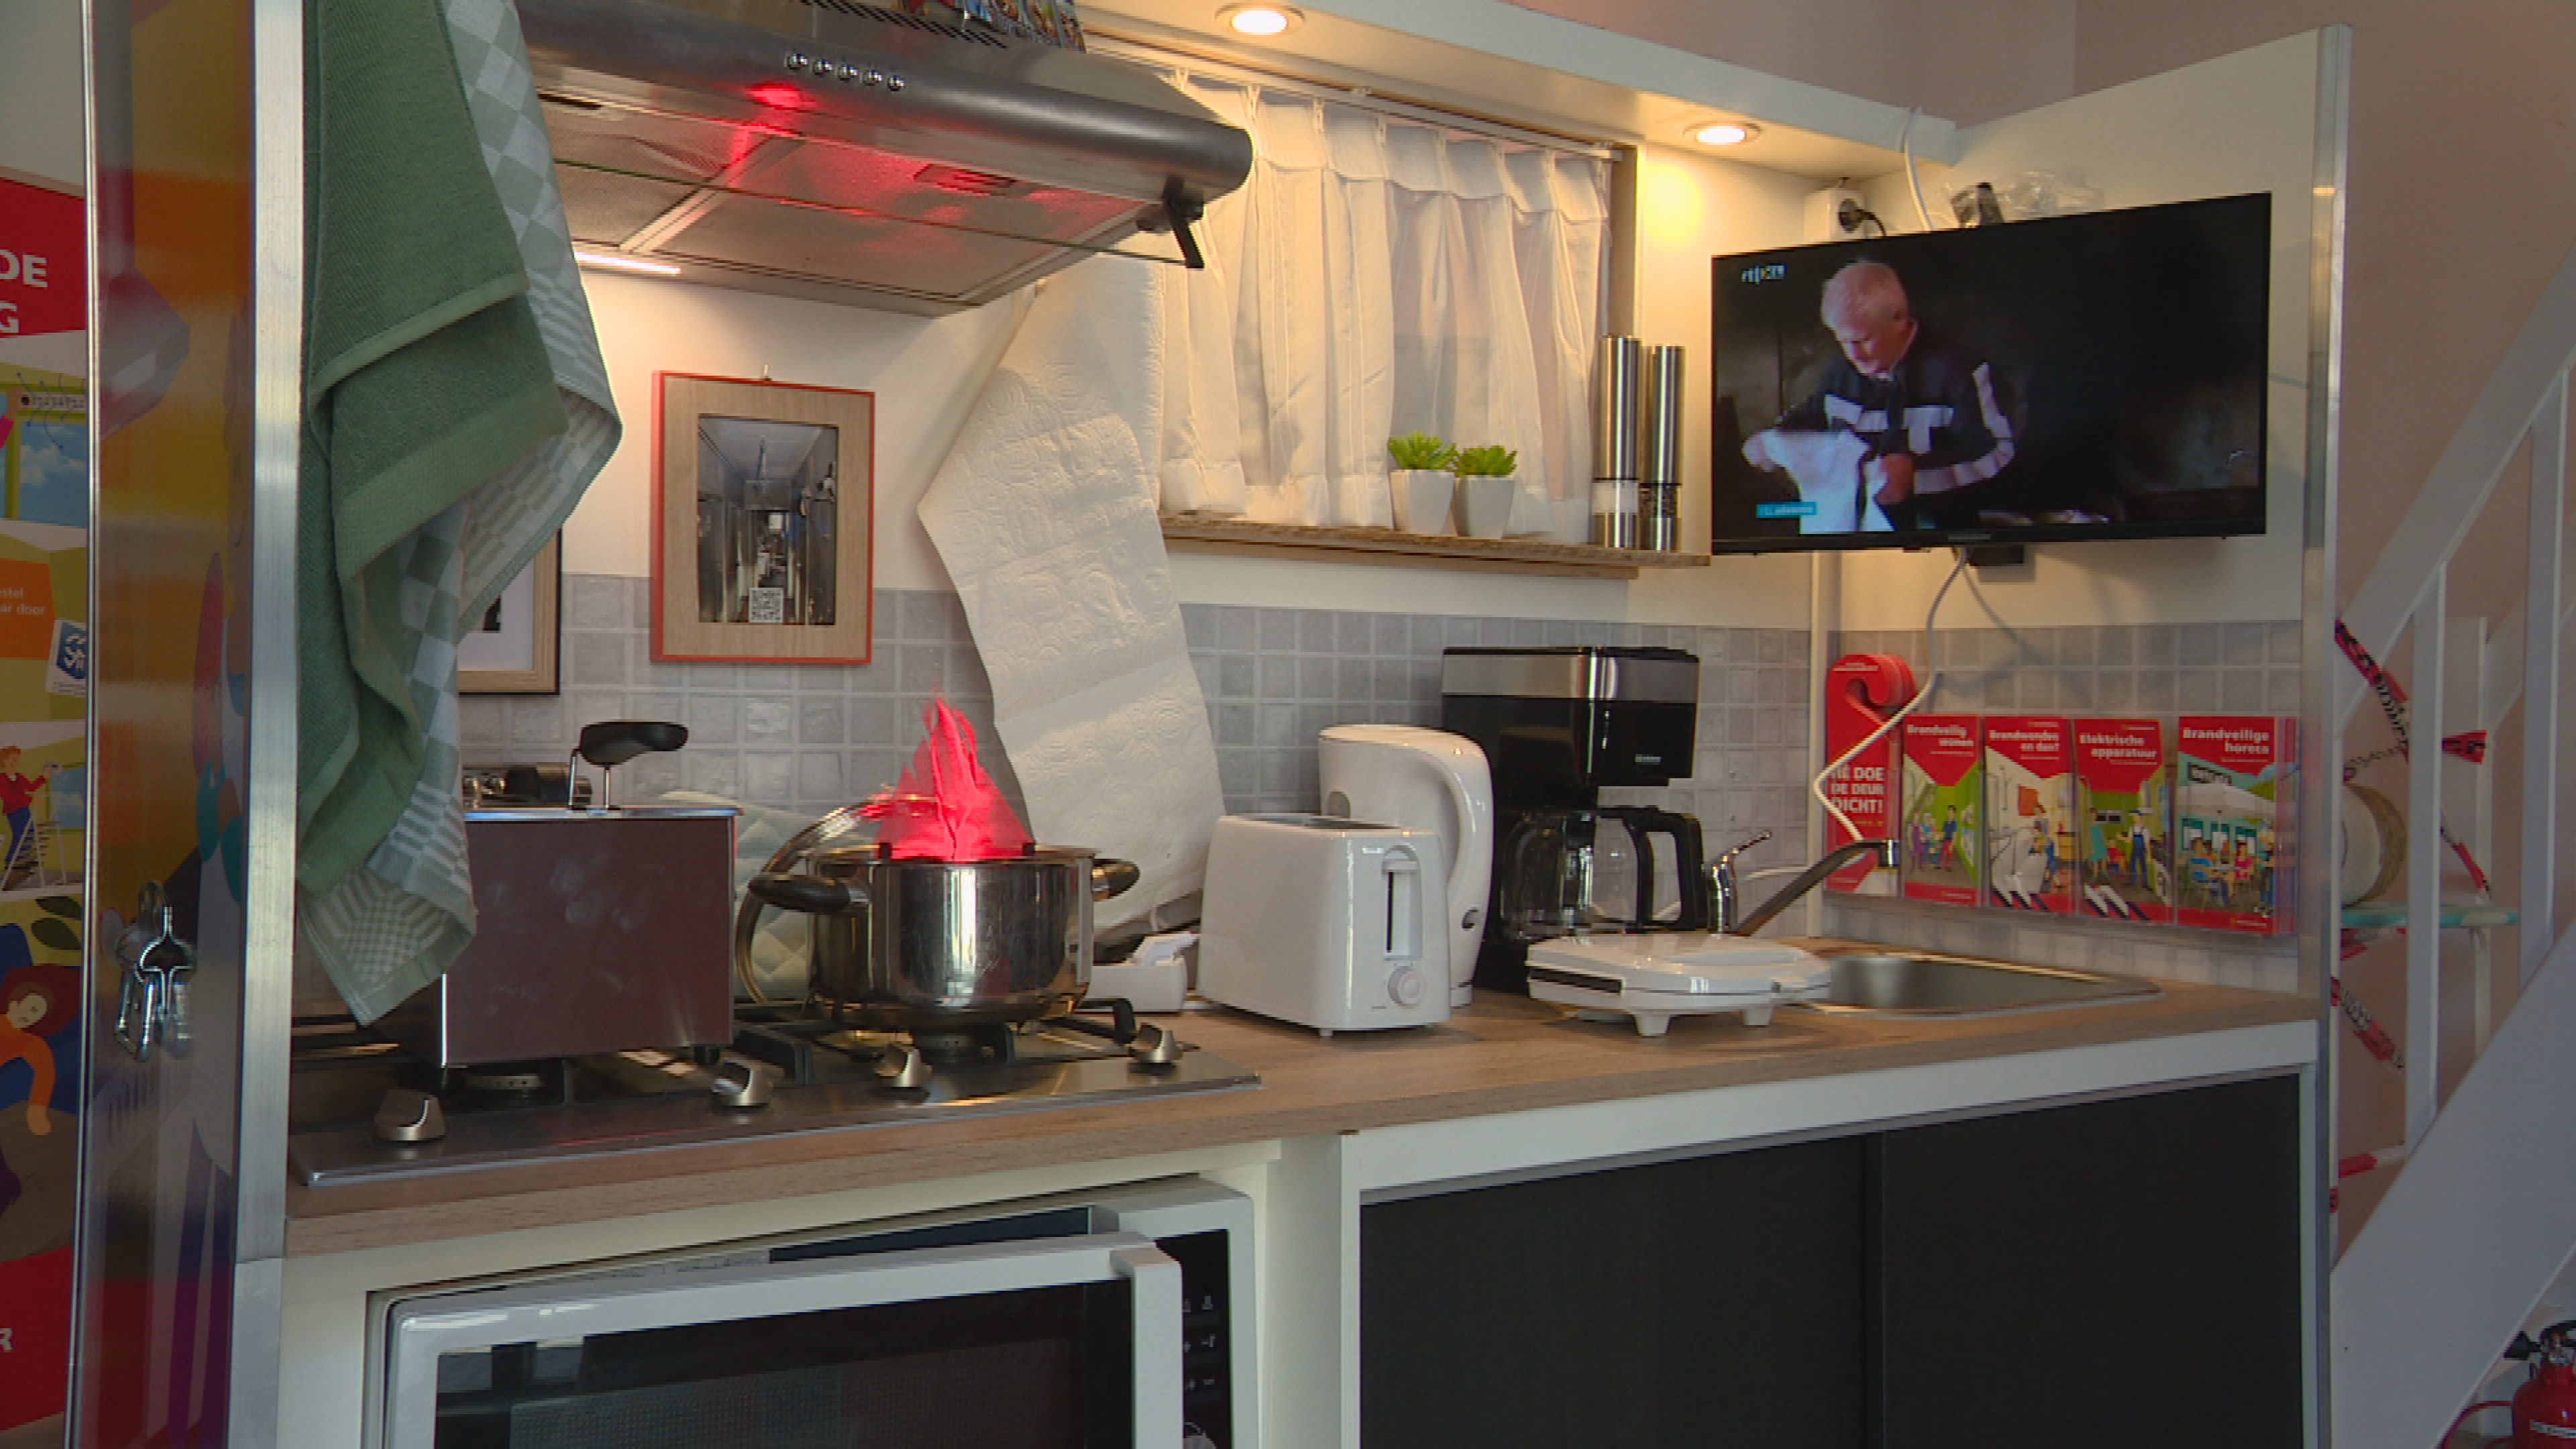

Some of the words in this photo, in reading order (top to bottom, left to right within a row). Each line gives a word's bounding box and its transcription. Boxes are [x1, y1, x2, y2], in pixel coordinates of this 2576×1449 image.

[2080, 734, 2145, 746] Elektrische
[2183, 728, 2269, 743] Brandveilige
[1854, 767, 1884, 781] DOE
[1851, 784, 1884, 796] DEUR
